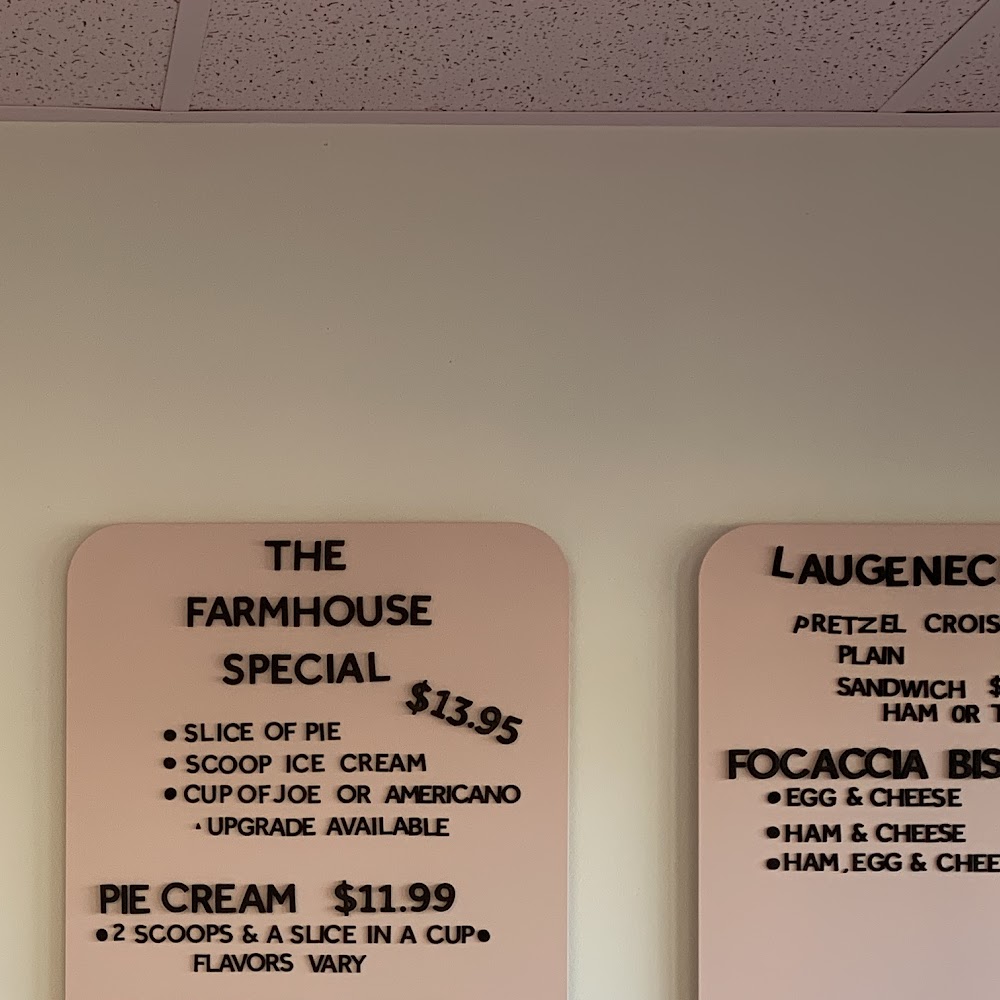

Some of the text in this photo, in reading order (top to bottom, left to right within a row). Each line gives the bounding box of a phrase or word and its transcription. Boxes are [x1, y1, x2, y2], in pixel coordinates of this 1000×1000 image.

[263, 539, 347, 572] THE
[771, 545, 998, 588] LAUGENEC
[186, 593, 433, 628] FARMHOUSE
[792, 613, 907, 636] PRETZEL
[838, 644, 905, 666] PLAIN
[221, 651, 391, 686] SPECIAL
[836, 676, 967, 700] SANDWICH
[404, 679, 523, 745] $13.95
[882, 702, 939, 723] HAM
[184, 721, 342, 743] SLICE OF PIE
[185, 752, 427, 775] SCOOP ICE CREAM
[725, 747, 1000, 780] FOCACCIA BIS
[336, 784, 372, 804] OR
[384, 783, 522, 805] AMERICANO
[785, 786, 963, 808] EGG & CHEESE
[207, 816, 450, 837] UPGRADE AVAILABLE
[783, 822, 967, 844] HAM & CHEESE
[909, 852, 928, 873] &
[99, 879, 456, 917] PIE CREAM $11.99
[134, 923, 234, 944] SCOOPS
[242, 924, 259, 944] &
[265, 924, 284, 944] A
[289, 924, 357, 945] SLICE
[367, 925, 392, 944] IN
[399, 925, 418, 945] A
[193, 952, 367, 974] FLAVORS VARY
